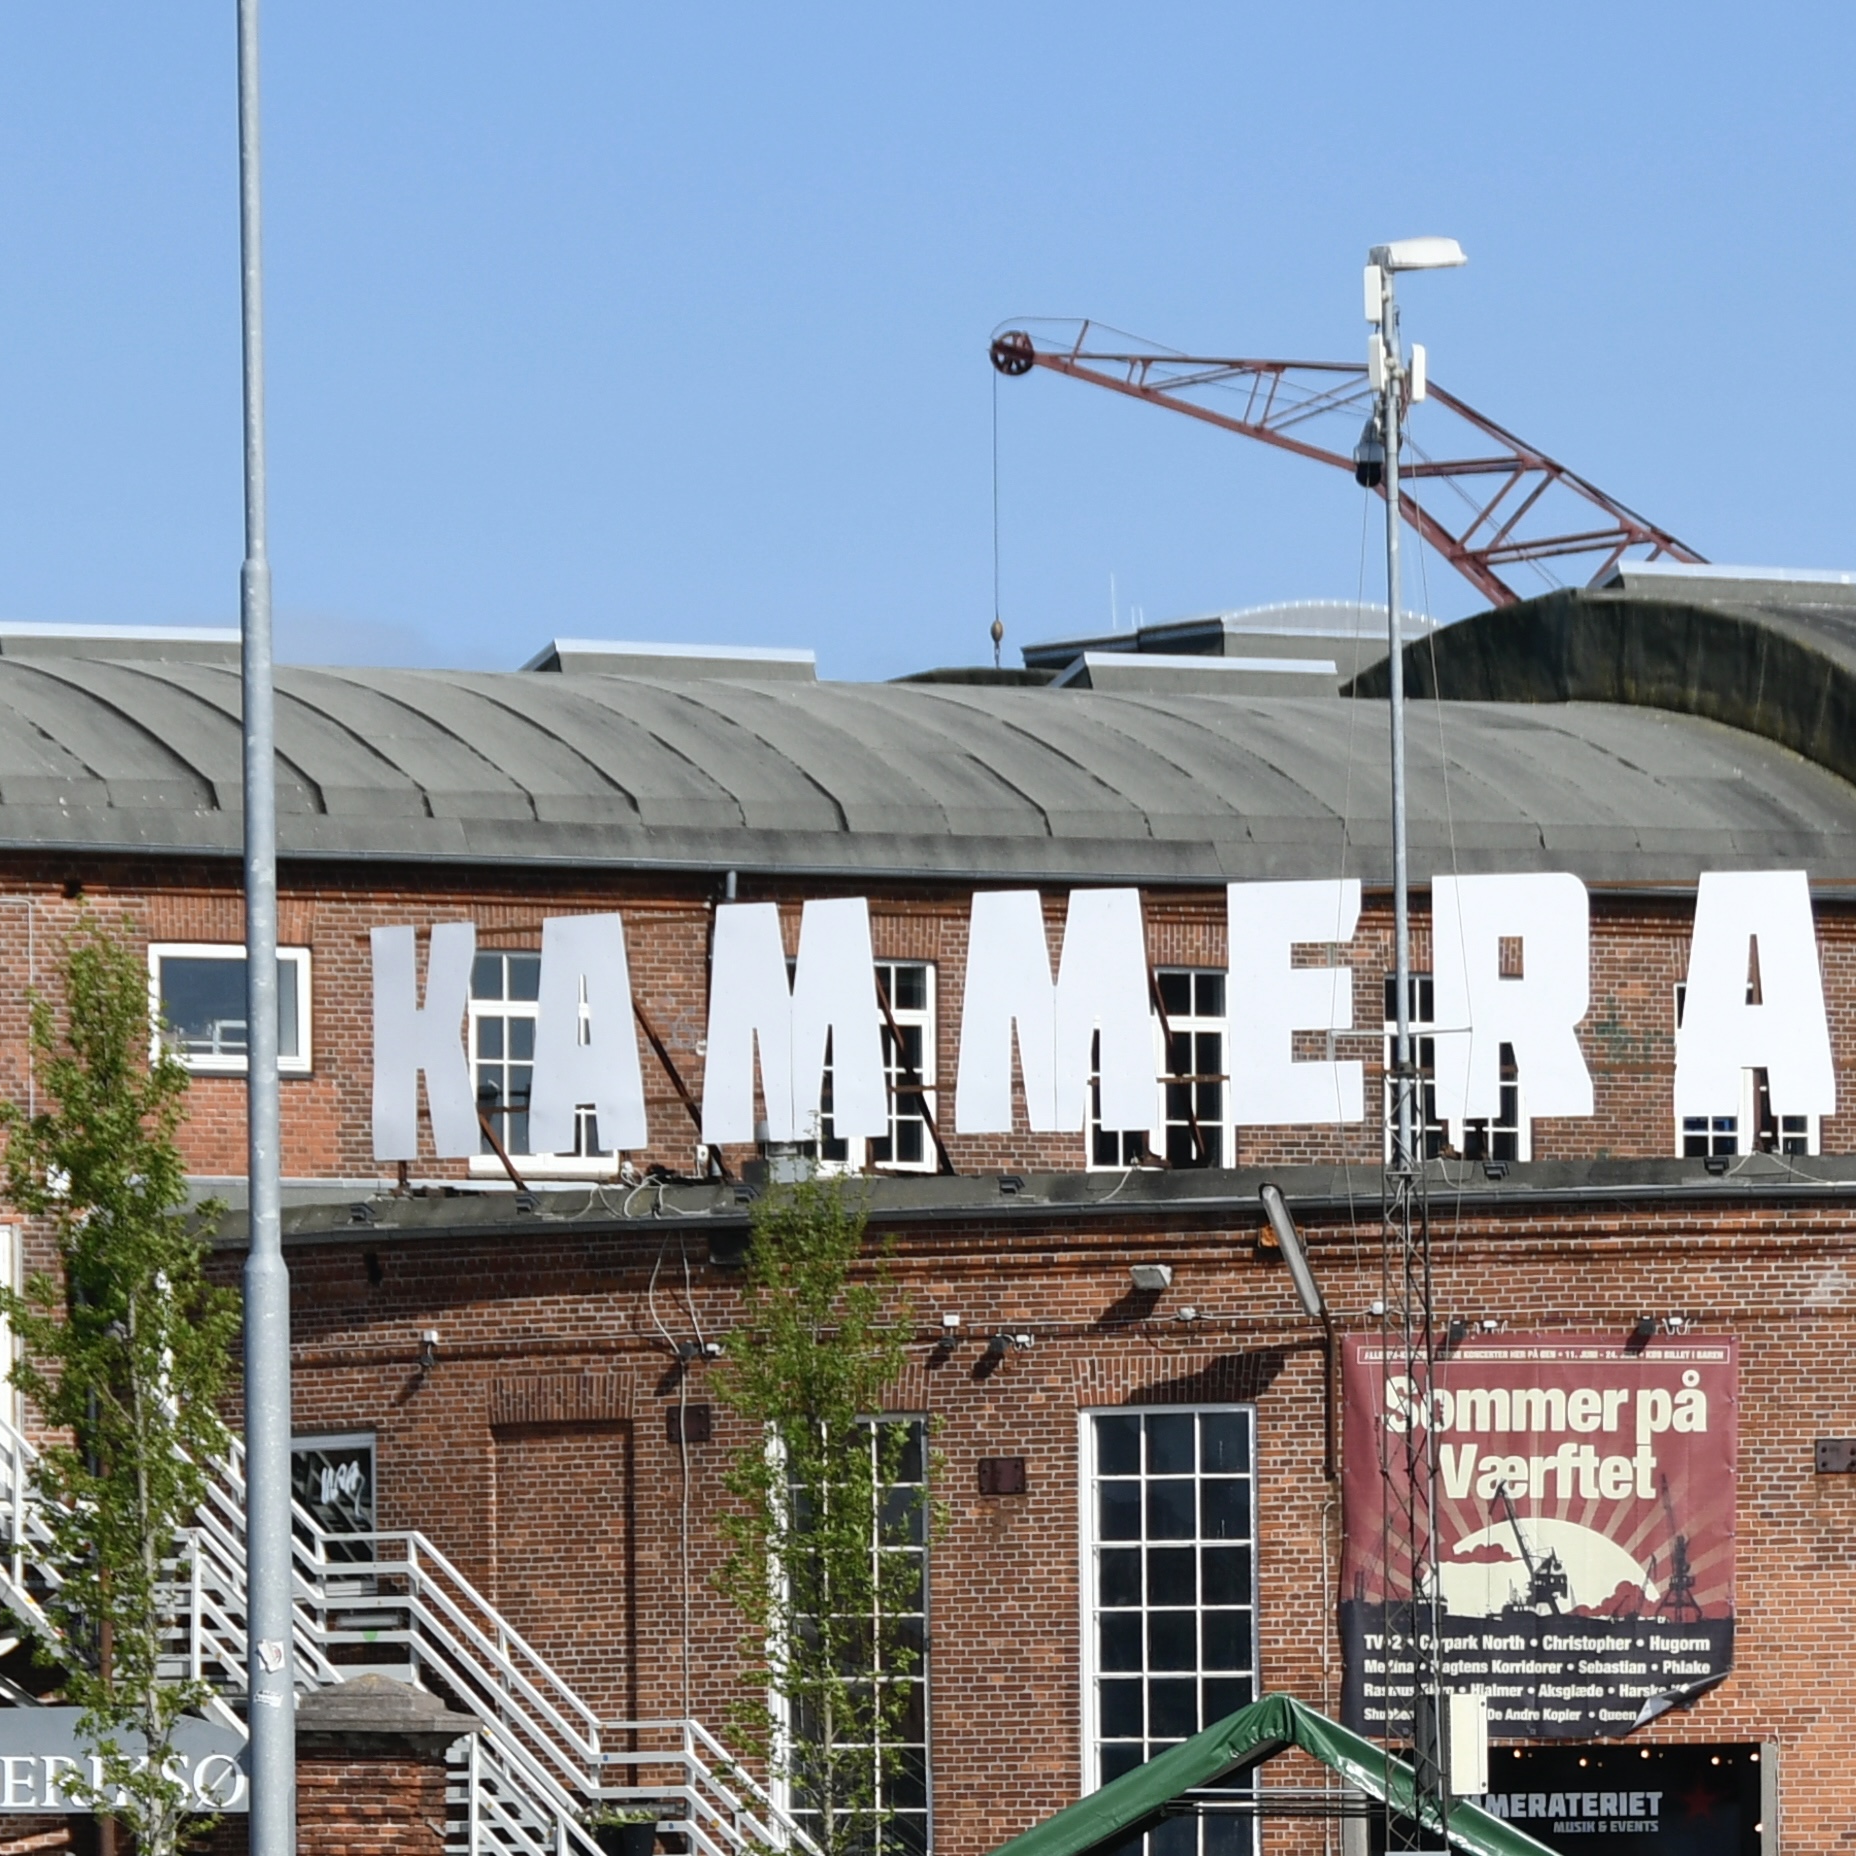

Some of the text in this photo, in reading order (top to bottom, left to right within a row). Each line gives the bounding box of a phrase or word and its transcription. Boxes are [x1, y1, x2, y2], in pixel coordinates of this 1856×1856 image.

[1382, 1369, 1707, 1445] Sommer på
[1439, 1443, 1657, 1499] Værftet
[1482, 1635, 1525, 1650] North
[1542, 1635, 1632, 1653] Christopher
[1649, 1635, 1710, 1653] Hugorm
[1491, 1660, 1562, 1674] Korridorer
[1578, 1660, 1646, 1674] Sebastian
[1663, 1660, 1711, 1674] Phlake
[1538, 1684, 1604, 1700] Aksglæde
[1505, 1708, 1540, 1721] Andre
[1472, 1792, 1663, 1818] MERATERIET
[1553, 1820, 1659, 1833] MUSIK & EVENTS
